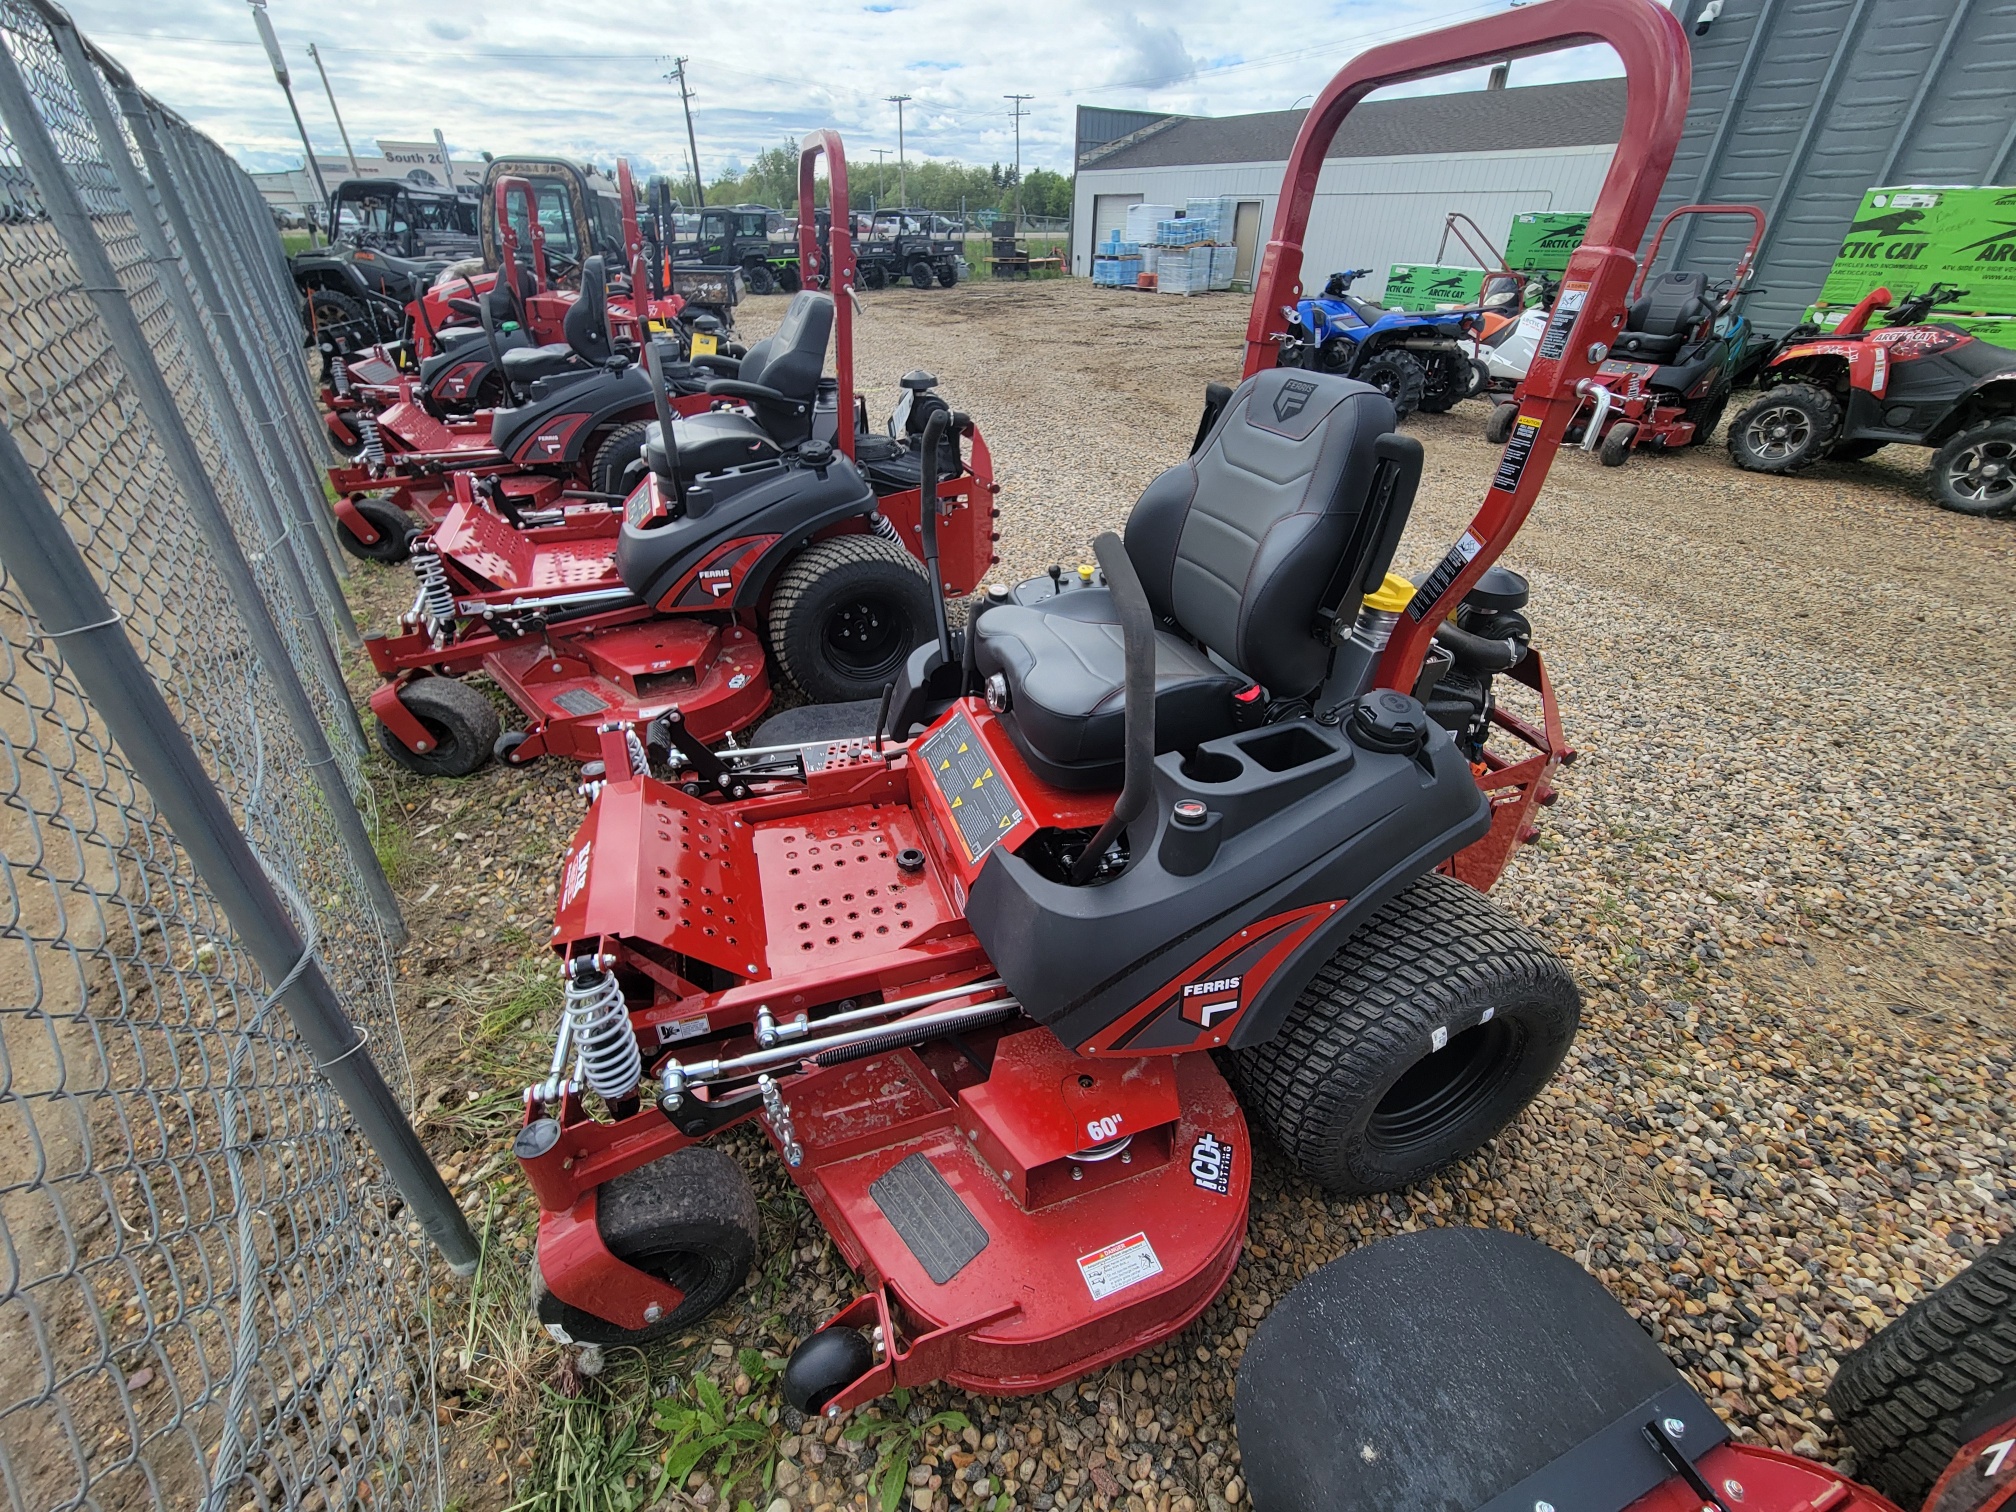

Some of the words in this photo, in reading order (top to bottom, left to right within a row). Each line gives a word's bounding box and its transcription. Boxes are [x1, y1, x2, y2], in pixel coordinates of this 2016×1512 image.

[385, 152, 424, 164] South
[1540, 240, 1571, 248] ARCTIC
[1885, 242, 1929, 260] CAT
[700, 282, 722, 290] 4x4
[1402, 285, 1415, 293] CAT
[1428, 288, 1452, 297] ARCTIC
[1452, 290, 1465, 298] CAT
[1874, 332, 1911, 342] ARCTIC
[1911, 331, 1934, 342] CAT
[1285, 380, 1315, 392] FERRIS
[699, 569, 730, 579] FERRIS
[1184, 976, 1240, 997] FERRIS
[1087, 1113, 1123, 1141] 60"
[1217, 1145, 1232, 1193] CUTTING
[1104, 1243, 1126, 1256] DANGER
